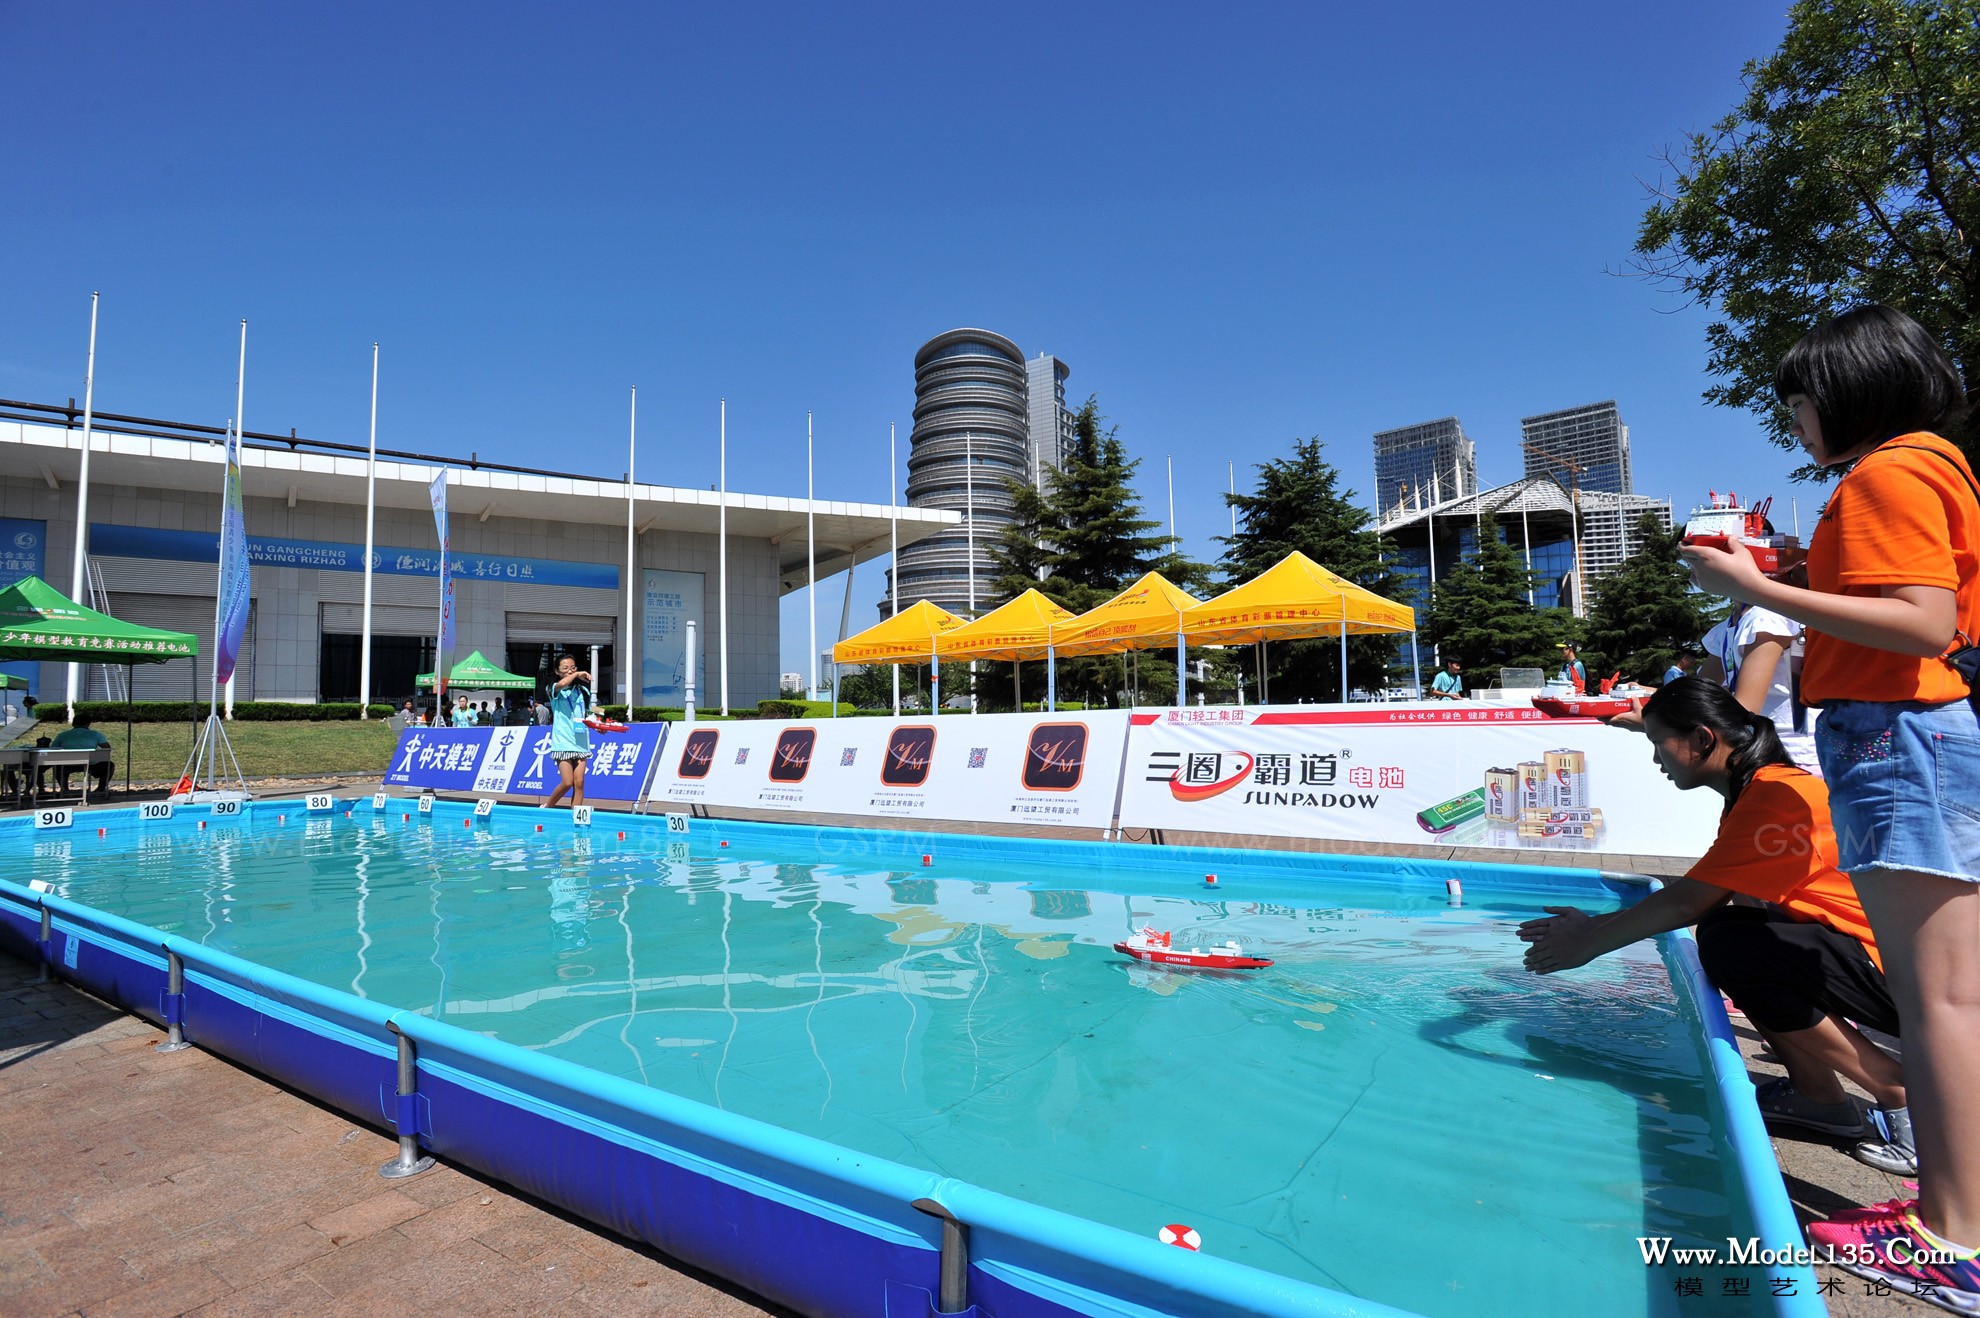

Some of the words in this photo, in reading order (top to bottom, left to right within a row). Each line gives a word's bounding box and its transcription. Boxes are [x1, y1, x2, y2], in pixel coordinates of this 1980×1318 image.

[267, 545, 346, 558] GANGCHENG
[247, 552, 296, 563] ANXING
[301, 557, 346, 566] RIZHAO
[1197, 607, 1320, 627] 山东省体育彩票管理中心
[1167, 709, 1243, 721] 厦门轻工集团
[1389, 712, 1436, 721] 为社会提供
[1467, 711, 1488, 721] 健康
[1494, 710, 1515, 720] 舒适
[1521, 710, 1543, 720] 便捷
[418, 743, 480, 771] 中天模型
[1349, 766, 1404, 789] 电池
[477, 778, 507, 791] 中天模型
[525, 781, 543, 789] MODEL
[311, 796, 328, 808] 80
[375, 795, 384, 807] 70
[420, 797, 430, 810] 60
[1243, 791, 1379, 809] SUNPADOW
[143, 804, 169, 817] 100
[216, 802, 236, 813] 90
[477, 801, 490, 813] 50
[42, 811, 65, 825] 90
[576, 809, 588, 822] 40
[670, 817, 684, 831] 30
[1165, 956, 1191, 964] CHINARE
